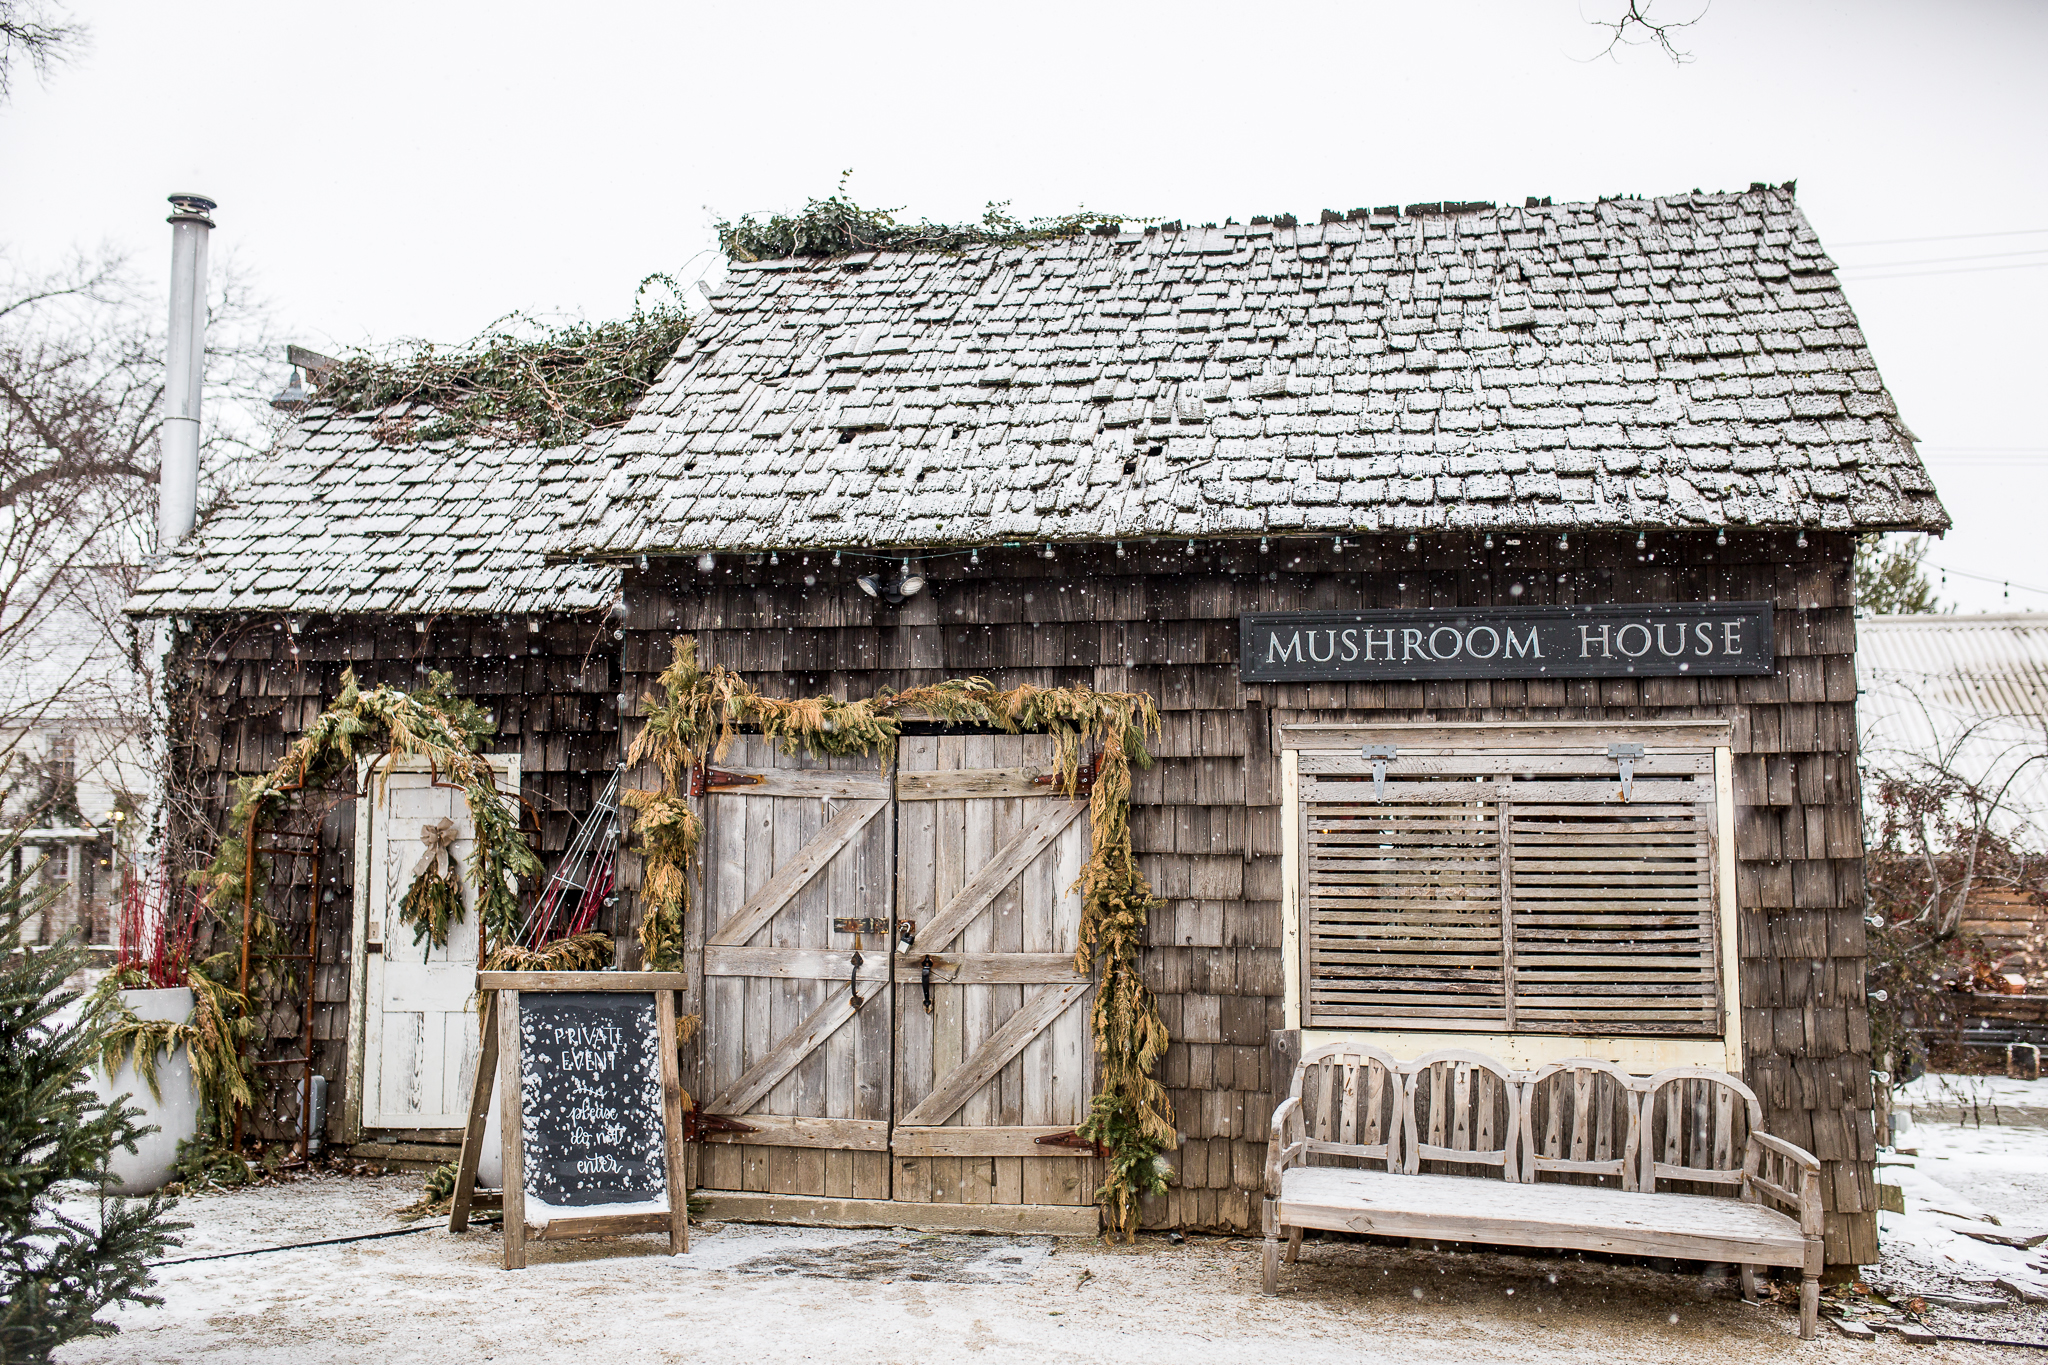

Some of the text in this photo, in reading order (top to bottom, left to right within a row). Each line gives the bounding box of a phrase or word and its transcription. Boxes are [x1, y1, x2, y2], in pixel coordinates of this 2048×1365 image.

[1266, 621, 1744, 664] MUSHROOM HOUSE
[554, 1027, 623, 1045] PRIVATE
[561, 1050, 618, 1071] EVENT
[566, 1097, 619, 1126] please
[570, 1125, 627, 1146] do not
[576, 1153, 623, 1174] enter
